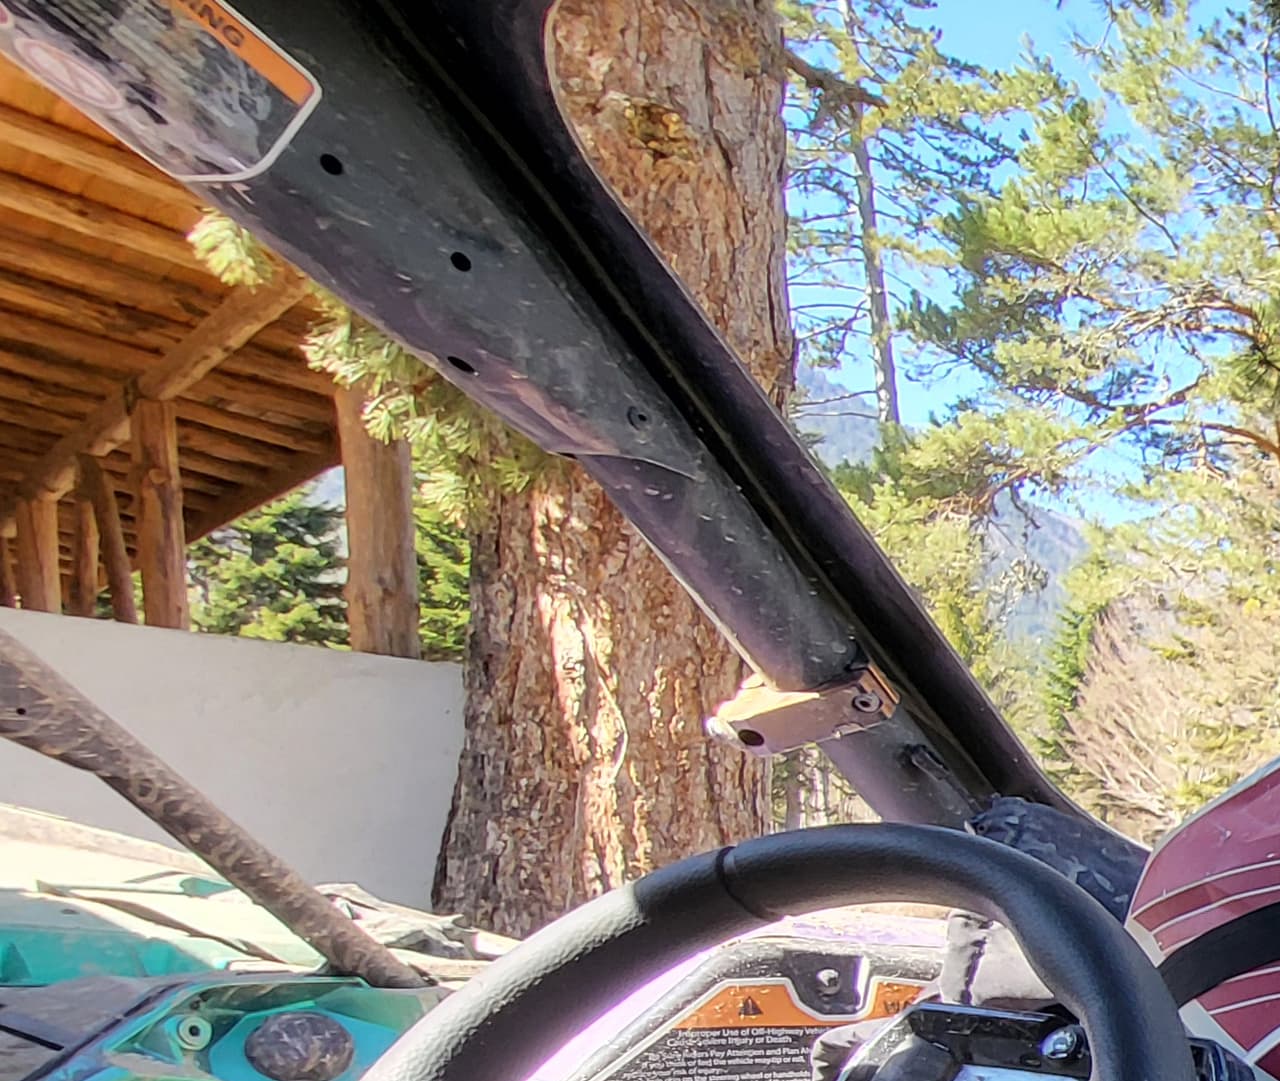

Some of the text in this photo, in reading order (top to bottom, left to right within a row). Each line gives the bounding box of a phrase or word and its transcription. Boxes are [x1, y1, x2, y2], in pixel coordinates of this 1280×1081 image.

[722, 1028, 740, 1036] Use
[740, 1028, 750, 1036] of
[751, 1026, 804, 1038] Off-Highway
[728, 1036, 754, 1047] Injury
[766, 1035, 792, 1044] Death
[766, 1047, 782, 1055] and
